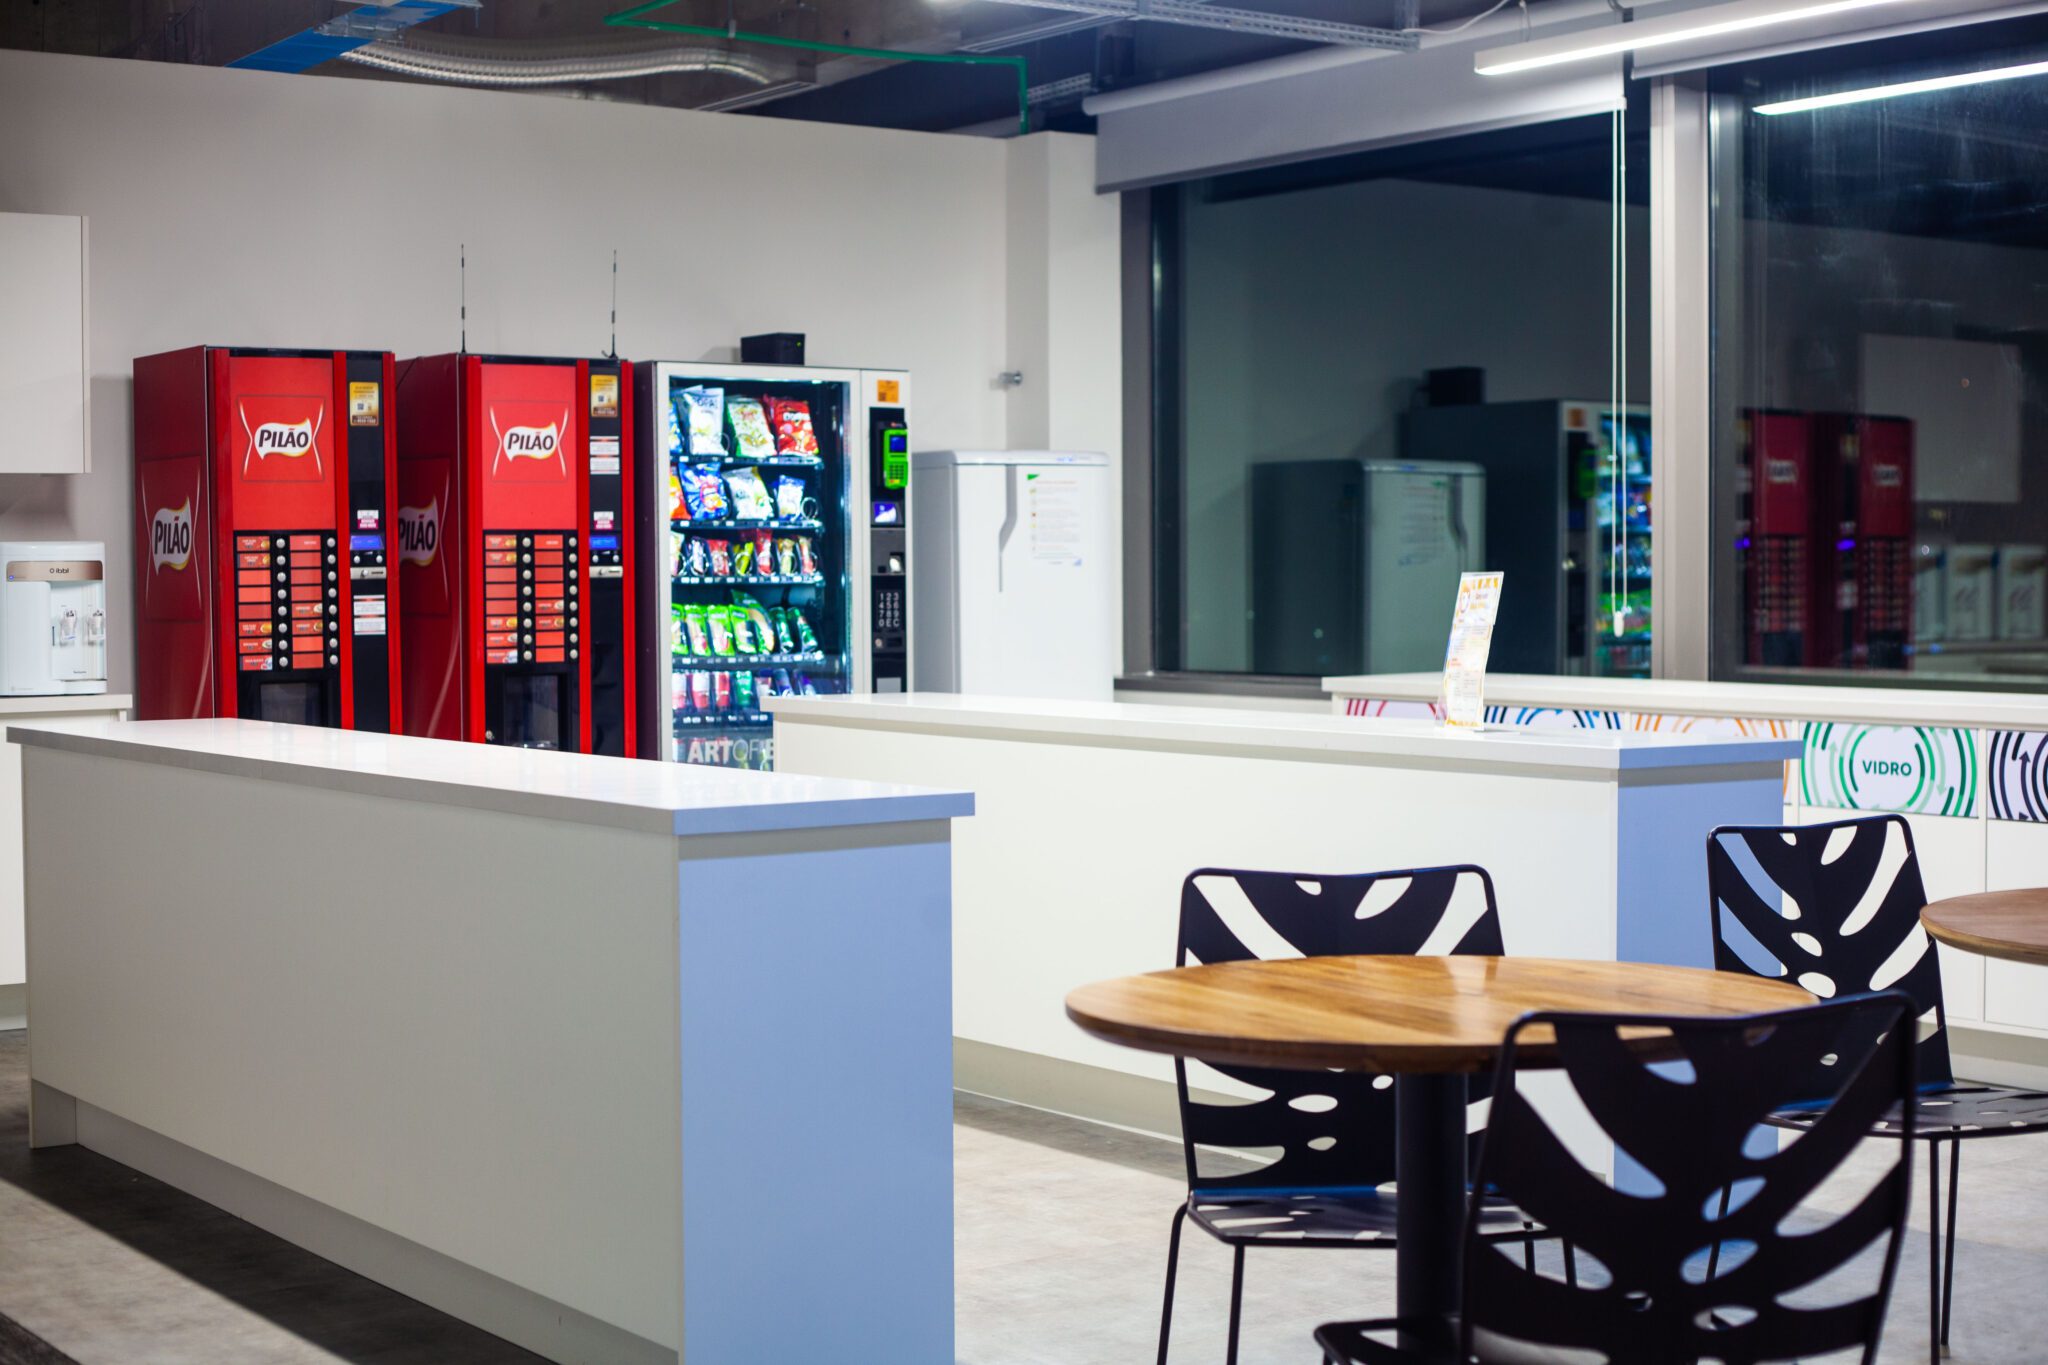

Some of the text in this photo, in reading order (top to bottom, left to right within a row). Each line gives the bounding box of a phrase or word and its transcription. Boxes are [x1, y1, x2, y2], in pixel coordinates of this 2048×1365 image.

[258, 428, 309, 449] PILÃO
[506, 431, 555, 451] PILÃO
[153, 515, 190, 555] PILÃO
[1862, 760, 1912, 777] VIDRO
